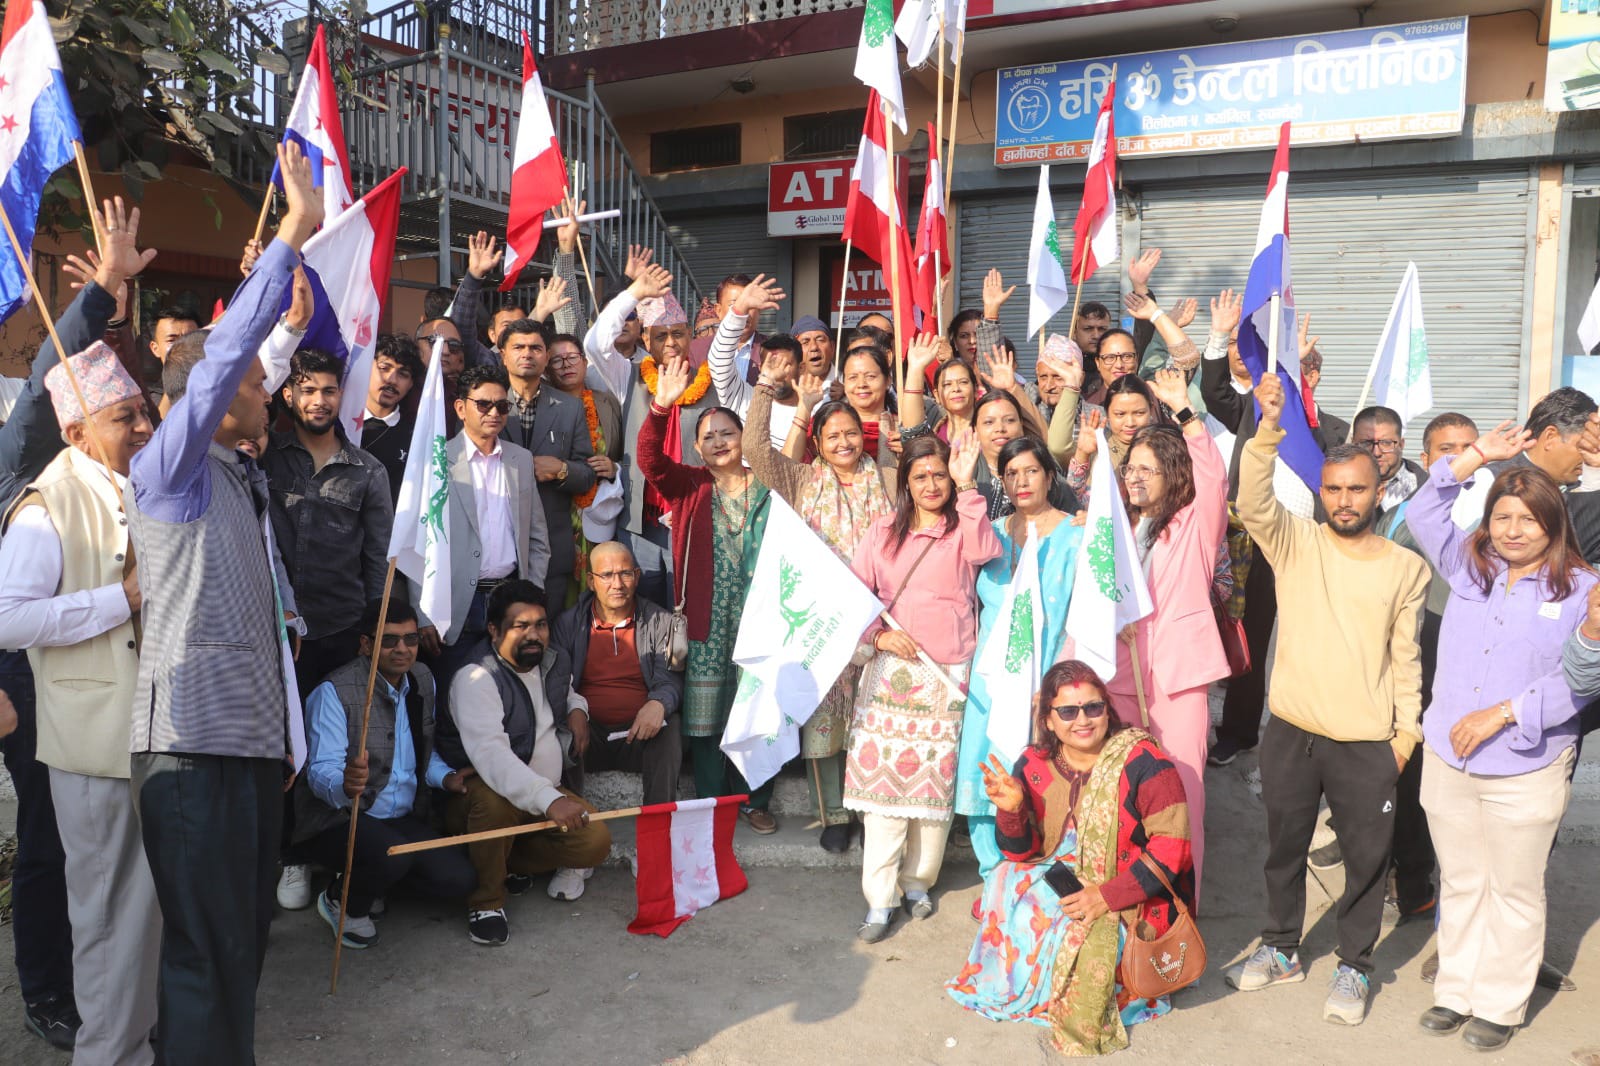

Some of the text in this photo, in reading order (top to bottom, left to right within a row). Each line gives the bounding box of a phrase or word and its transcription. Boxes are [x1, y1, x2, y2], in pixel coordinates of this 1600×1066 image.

[1009, 77, 1049, 93] HARI OM
[1059, 62, 1113, 120] हरि
[1172, 54, 1281, 106] डेन्टल
[1292, 31, 1463, 96] क्लिनिक
[783, 167, 853, 204] AT
[808, 215, 830, 224] Global
